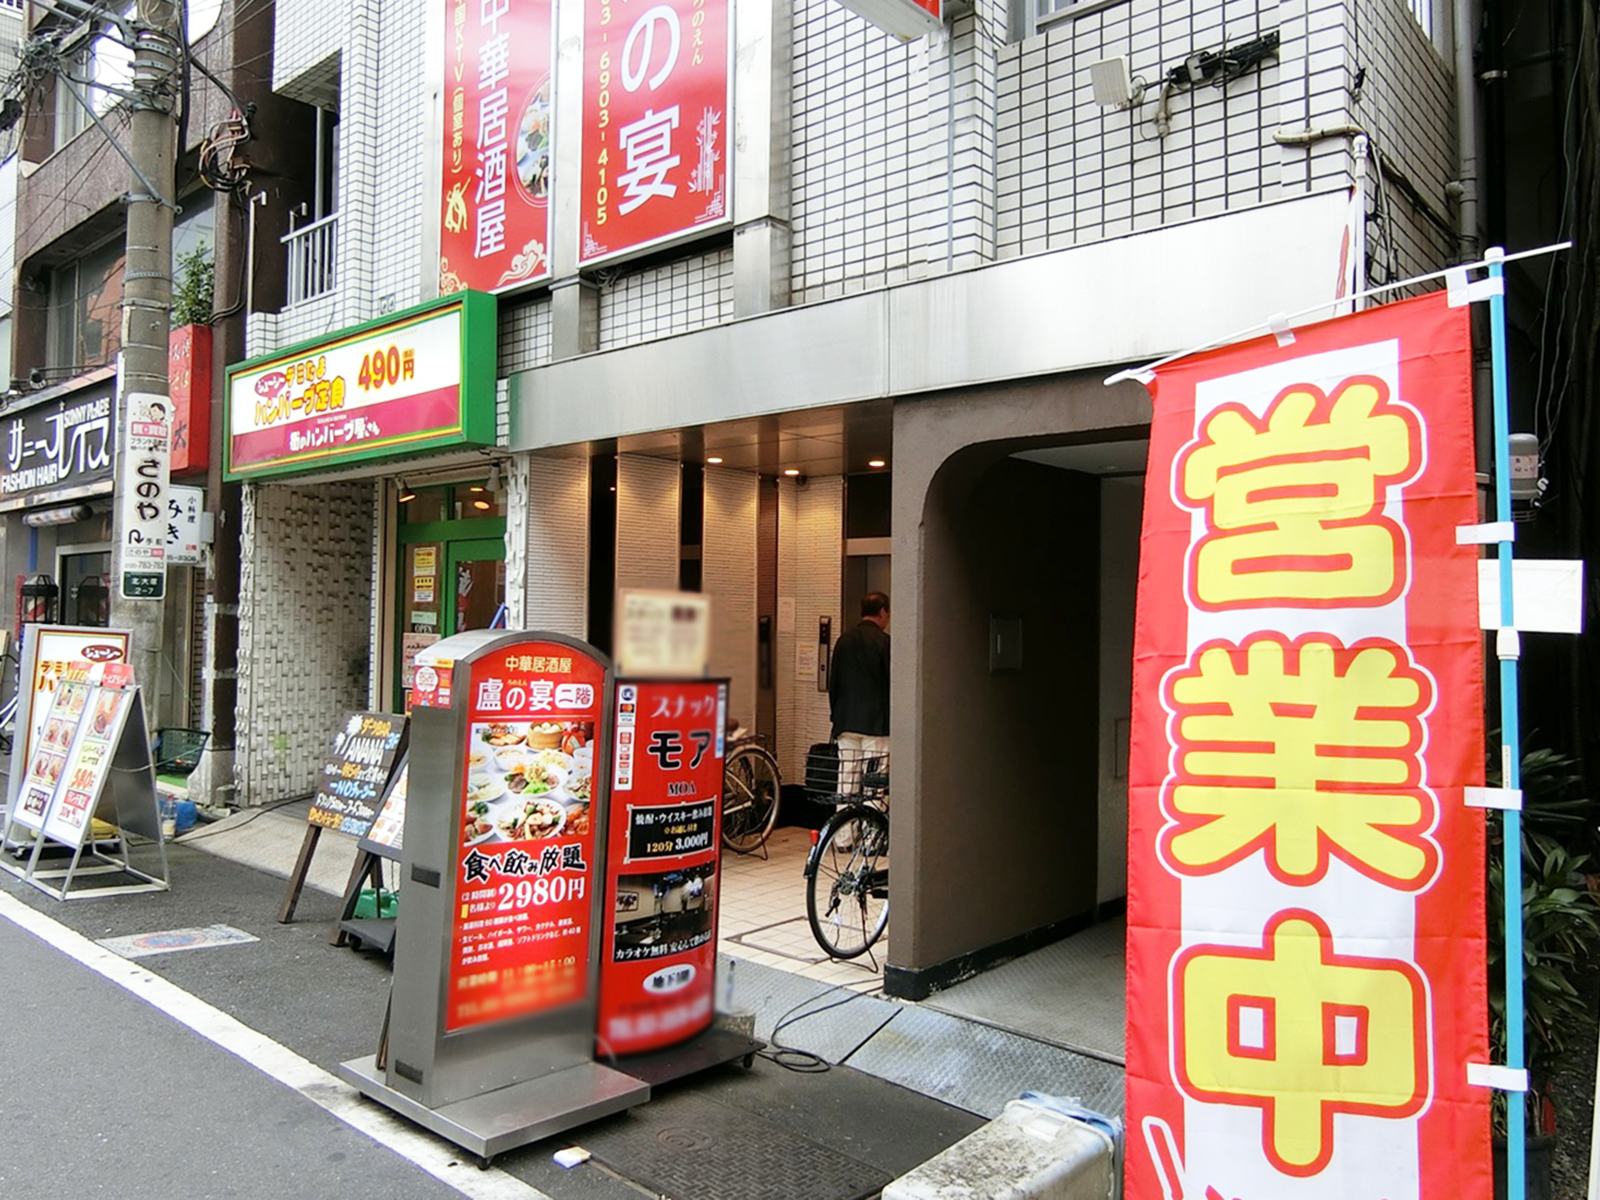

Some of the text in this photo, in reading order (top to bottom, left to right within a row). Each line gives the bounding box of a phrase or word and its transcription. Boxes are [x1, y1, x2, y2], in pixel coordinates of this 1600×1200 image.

[474, 0, 510, 260] 中華居酒屋
[596, 0, 612, 226] 3-6903-4105
[357, 344, 415, 392] 490円
[254, 375, 347, 426] ハンバーグ定食
[1, 462, 58, 493] FASHION HAIR
[136, 458, 161, 521] さのや
[505, 655, 573, 674] 中華居酒屋
[650, 695, 716, 718] スナック
[648, 730, 712, 770] モア
[667, 781, 697, 797] MOA
[1156, 374, 1443, 1171] 営業中
[463, 843, 588, 885] 食べ飲み放題
[646, 841, 674, 853] 120分
[497, 876, 586, 912] 2980円
[616, 943, 668, 960] カラオケ無料
